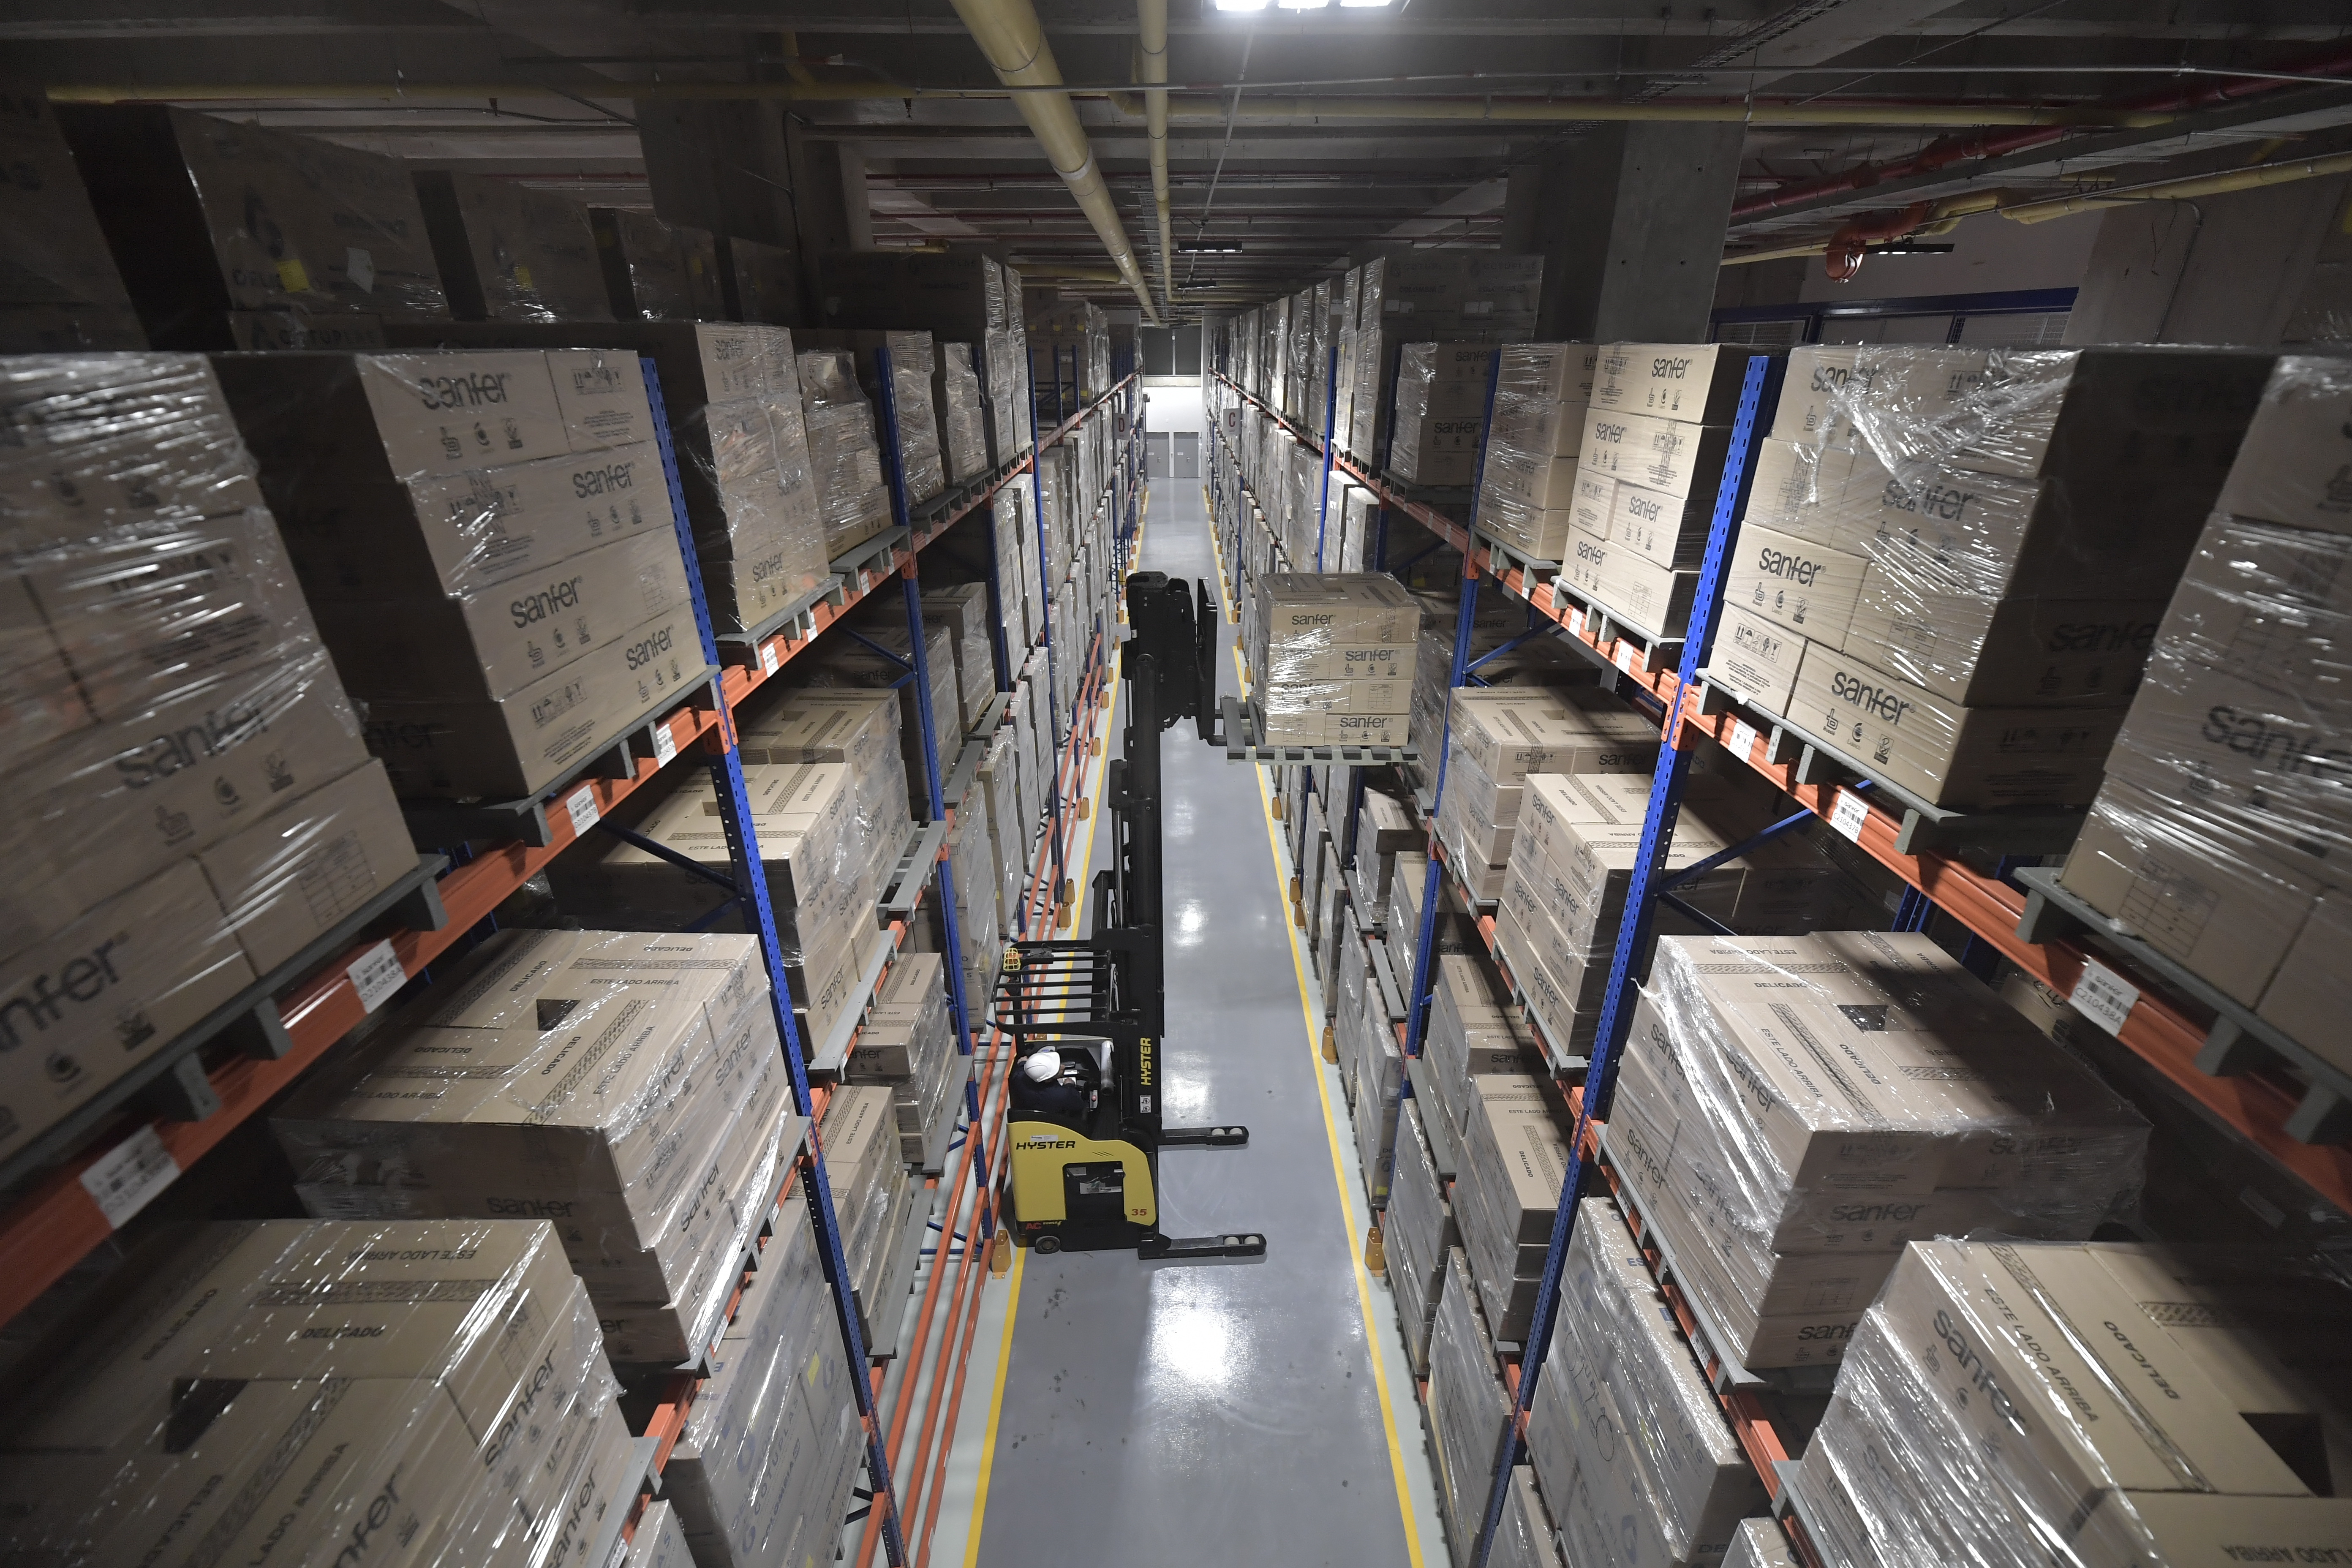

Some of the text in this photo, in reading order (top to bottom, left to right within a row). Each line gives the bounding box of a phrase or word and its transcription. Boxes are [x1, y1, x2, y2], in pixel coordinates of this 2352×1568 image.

[1652, 357, 1691, 380] sanfer
[421, 372, 510, 410] sanfer
[1119, 417, 1125, 432] D
[1229, 412, 1236, 427] C
[1434, 420, 1478, 434] sanfer
[1595, 421, 1625, 444] sanfer
[572, 463, 633, 498] sanfer
[1628, 495, 1662, 523] sanfer
[752, 552, 782, 583] sanfer
[1577, 540, 1606, 566] sanfer
[1759, 547, 1822, 587] sanfer
[510, 576, 580, 629] sanfer
[1292, 614, 1333, 625] sanfer
[625, 625, 672, 671] sanfer
[1345, 649, 1394, 661] sanfer
[1831, 671, 1910, 726] sanfer
[1339, 717, 1388, 728] sanfer
[1532, 794, 1556, 825] sanfer
[1833, 812, 1859, 835] C210437B
[1514, 880, 1537, 913] sanfer
[1554, 878, 1580, 916] sanfer
[509, 960, 547, 993] DELICADO
[821, 965, 844, 1010] sanfer
[541, 1035, 581, 1075] DELICADO
[614, 1053, 632, 1073] LADO
[630, 1025, 656, 1053] ARRIBA
[715, 1025, 753, 1087] sanfer
[1141, 1037, 1151, 1086] HYSTER
[1761, 1028, 1823, 1099] ESTE LADO ARRIBA
[1839, 1043, 1882, 1086] DELICADO
[846, 1102, 869, 1144] ESTE LADO ARRIBA
[1016, 1141, 1075, 1149] HYSTER
[1519, 1150, 1534, 1178] DELICADO
[1626, 1128, 1666, 1189] sanfer
[485, 1196, 576, 1218] sanfer
[680, 1163, 720, 1232] sanfer
[1830, 1203, 1925, 1222] sanfer
[1798, 1321, 1857, 1341] sanf
[1933, 1310, 2025, 1430] sanfer
[1984, 1285, 2099, 1423] ESTE LADO ARRIBA
[2103, 1320, 2181, 1400] DELICADO
[484, 1349, 558, 1472] sanfer
[334, 1466, 403, 1568] nfer
[549, 1469, 598, 1568] anfer
